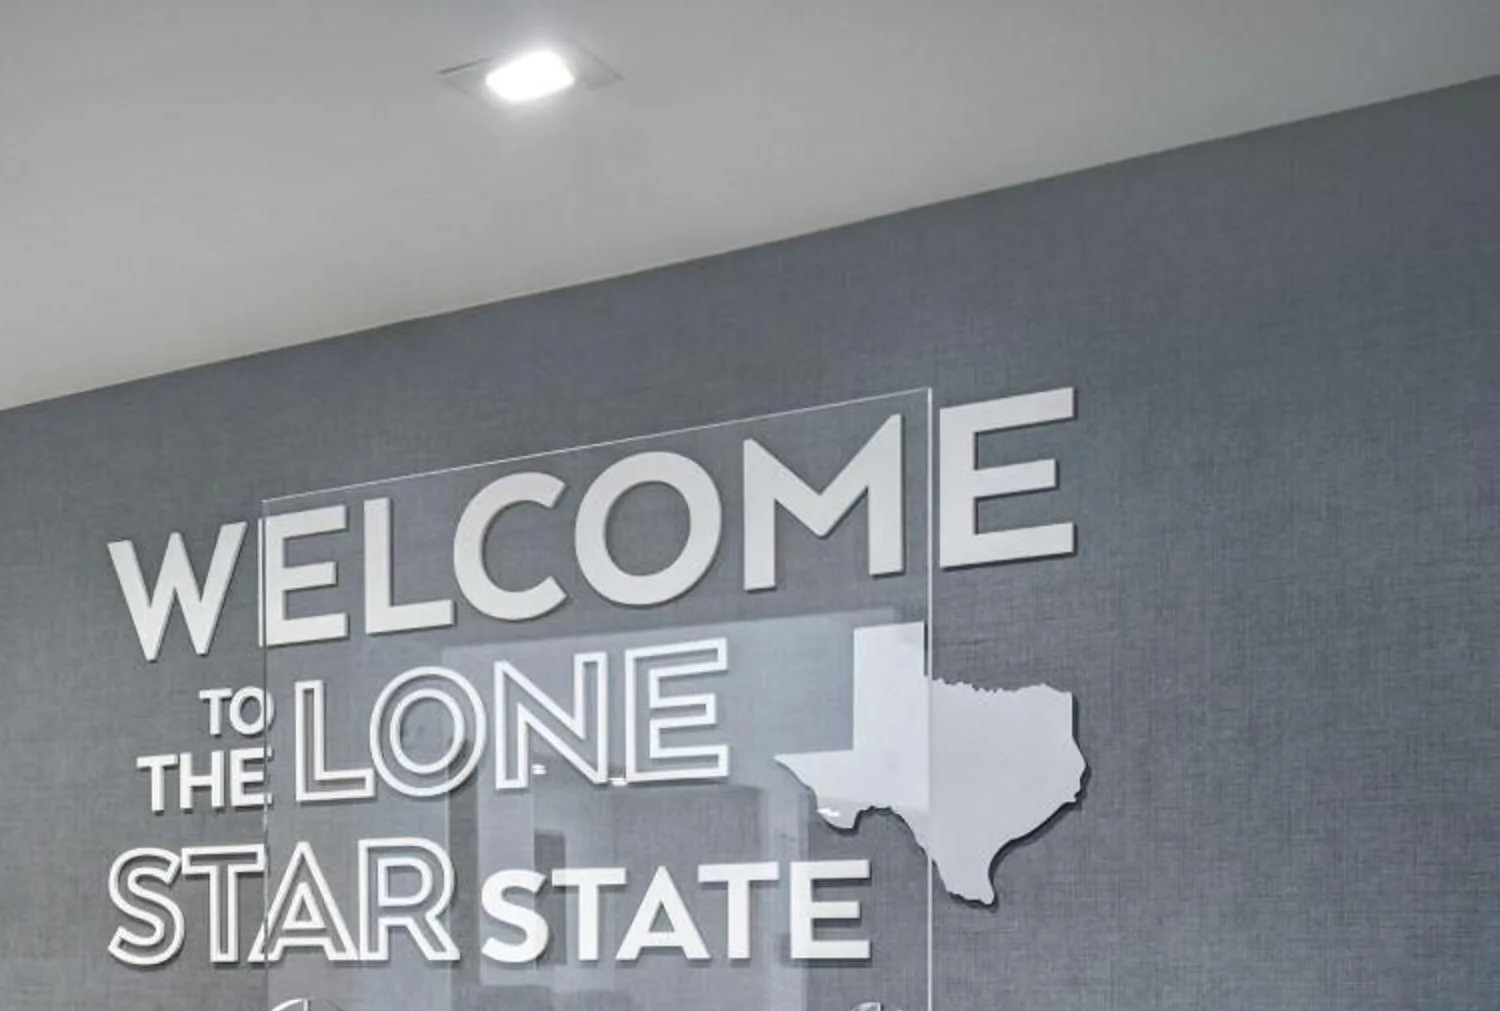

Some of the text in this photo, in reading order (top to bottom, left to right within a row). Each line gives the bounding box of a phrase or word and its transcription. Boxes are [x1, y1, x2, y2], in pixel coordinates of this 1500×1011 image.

[107, 386, 1076, 662] WELCOME
[198, 685, 276, 736] TO
[294, 637, 729, 803] LONE
[136, 747, 274, 813] THE
[108, 837, 871, 966] STAR STATE
